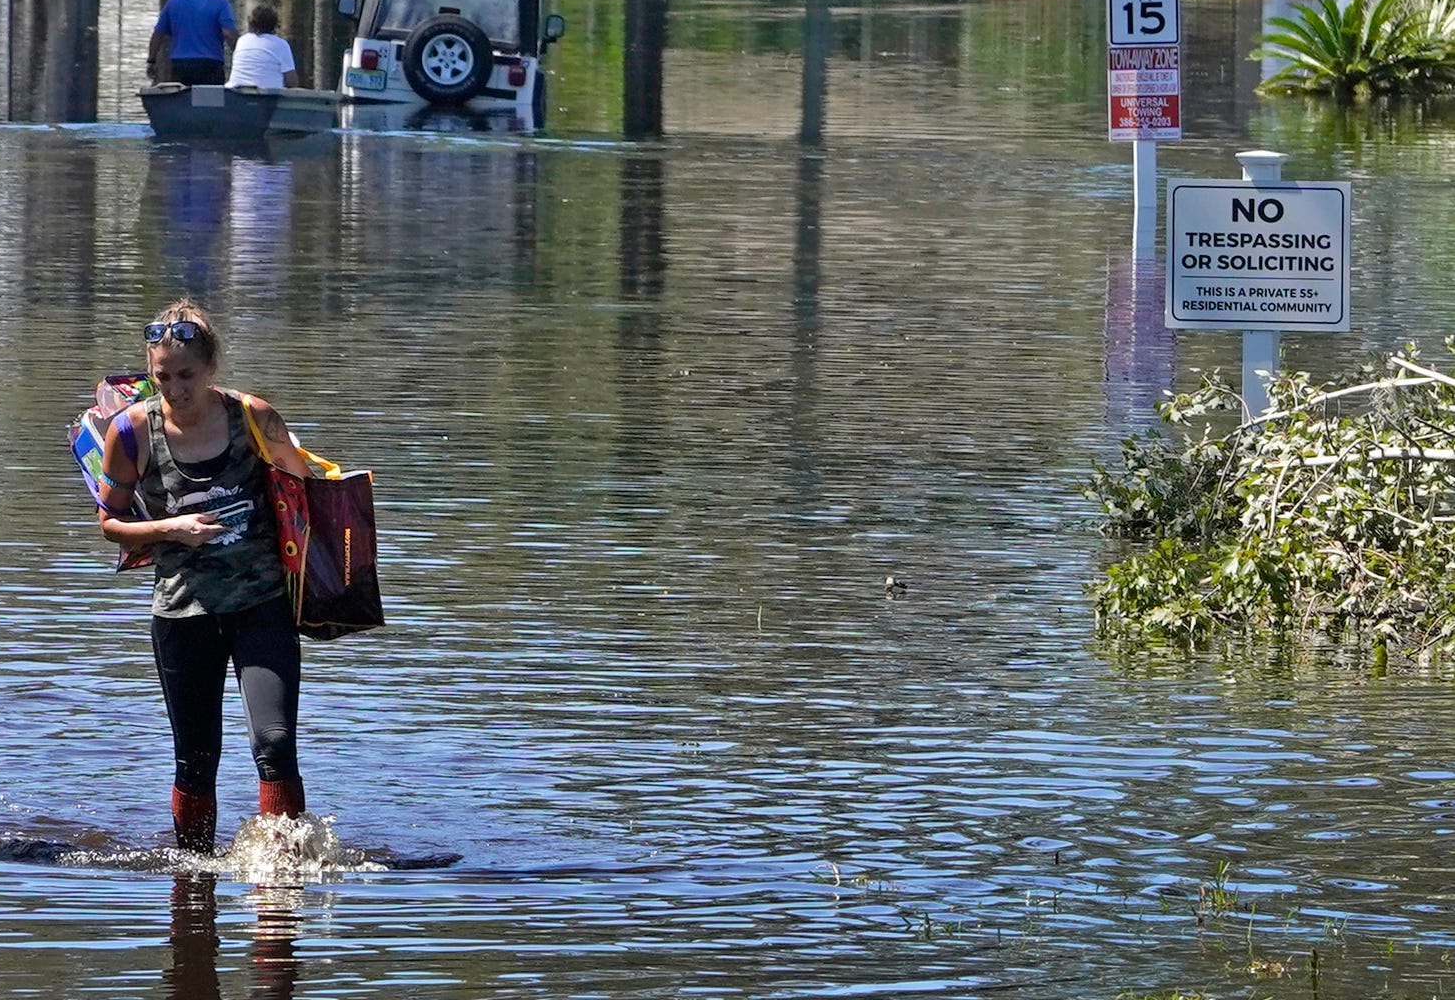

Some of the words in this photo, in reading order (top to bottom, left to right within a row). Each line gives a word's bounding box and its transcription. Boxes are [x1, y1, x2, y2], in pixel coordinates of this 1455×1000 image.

[1123, 2, 1166, 34] 15
[1111, 48, 1154, 69] TOW-AWAY
[1155, 47, 1178, 69] ZONE
[1120, 98, 1169, 107] UNIVERSAL
[1128, 108, 1162, 116] TOWING
[1232, 198, 1284, 223] NO
[1185, 232, 1331, 249] TRESPASSING
[1181, 254, 1211, 270] OR
[1217, 255, 1334, 271] SOLICITING
[1196, 287, 1222, 297] THIS
[1225, 287, 1235, 297] IS
[1238, 288, 1246, 297] A
[1249, 288, 1296, 298] PRIVATE
[1299, 289, 1319, 299] 55+
[1182, 301, 1257, 312] RESIDENTIAL
[1260, 302, 1332, 313] COMMUNITY
